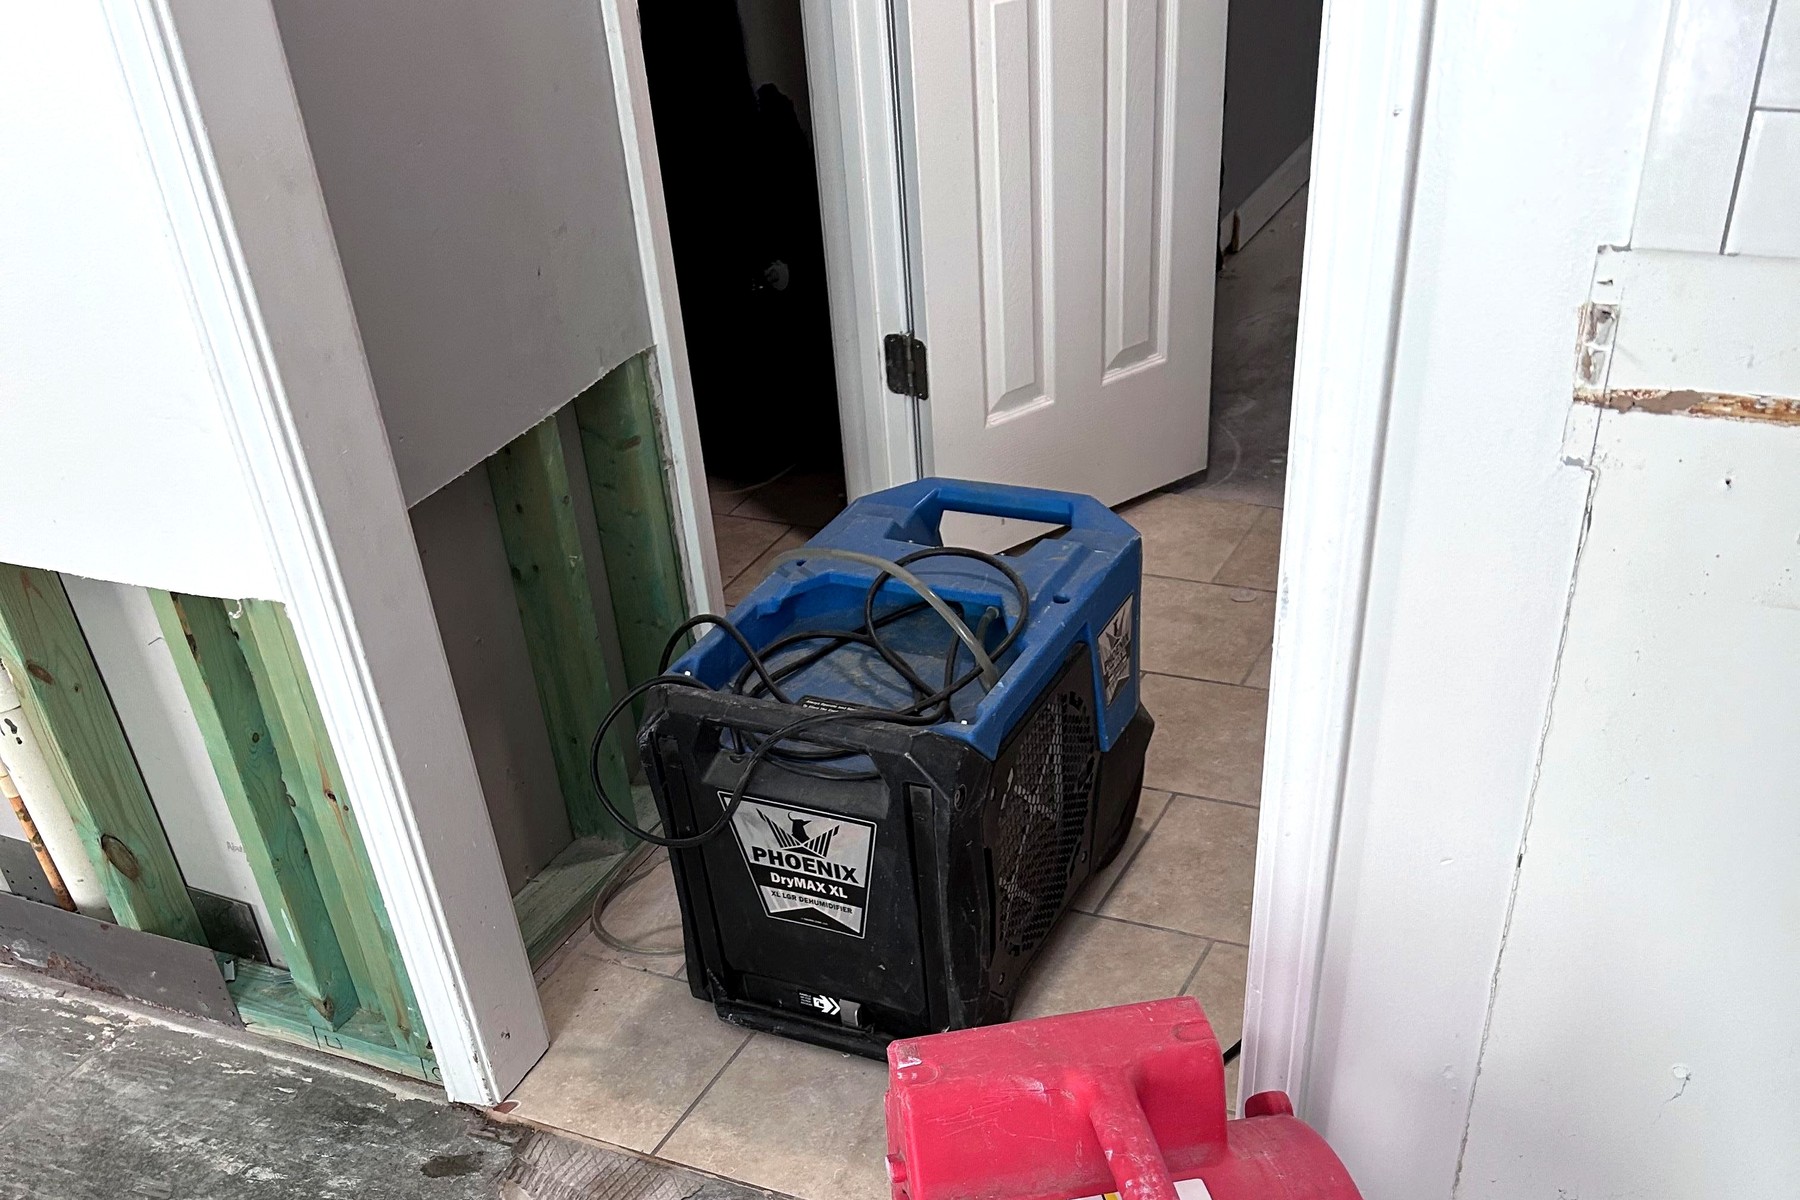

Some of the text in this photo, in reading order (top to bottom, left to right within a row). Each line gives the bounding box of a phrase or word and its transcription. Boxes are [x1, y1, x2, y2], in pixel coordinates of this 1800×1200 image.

[752, 846, 859, 885] PHOENIX
[770, 872, 848, 899] DryMAX XL
[771, 890, 781, 898] XL
[799, 897, 853, 914] DEHUMIDIFIER
